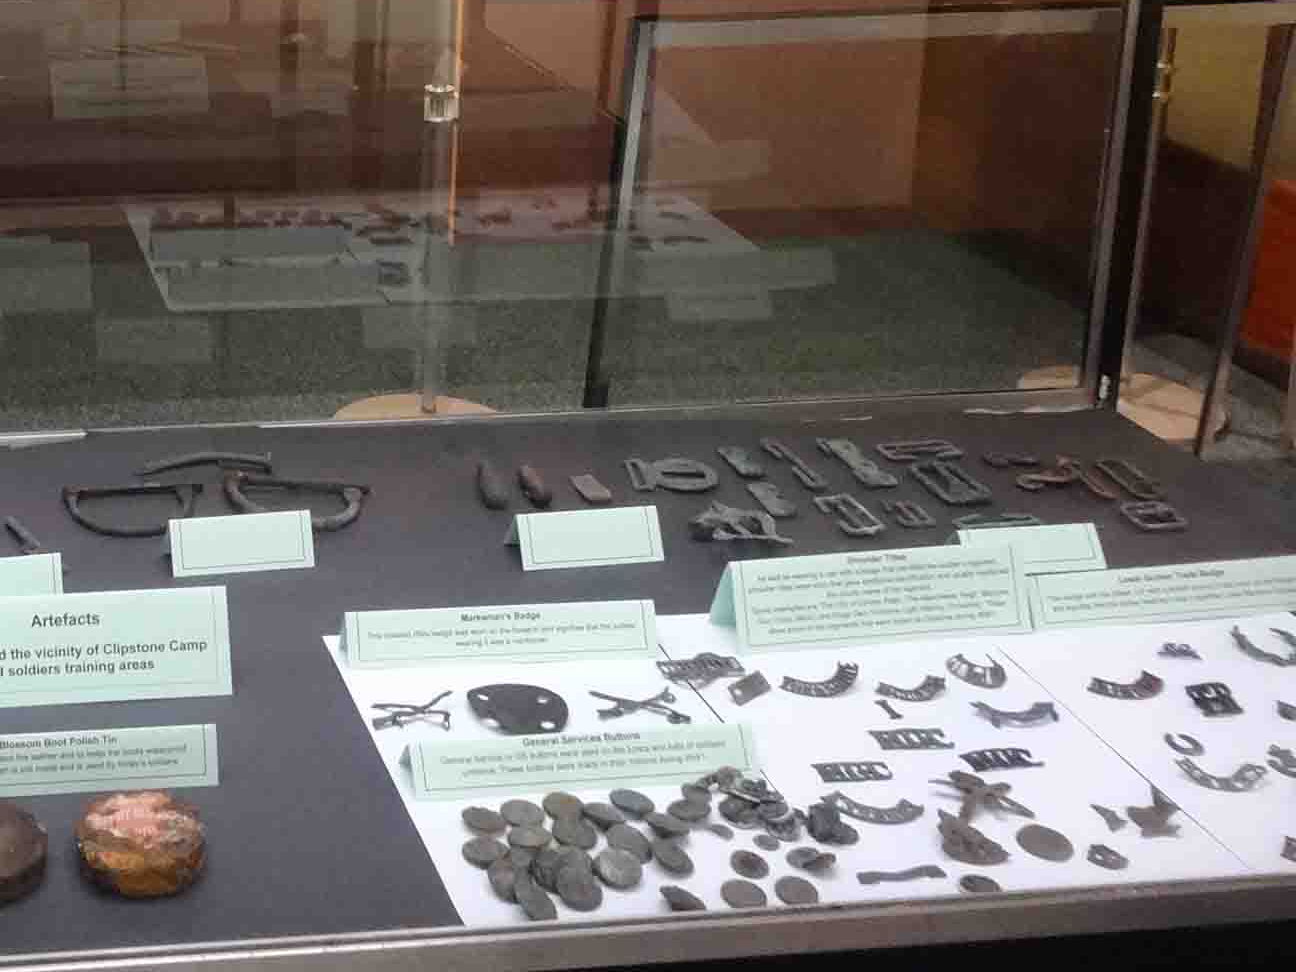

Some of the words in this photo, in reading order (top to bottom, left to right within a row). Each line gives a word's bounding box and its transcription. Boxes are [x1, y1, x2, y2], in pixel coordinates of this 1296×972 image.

[30, 611, 101, 629] Artefacts
[10, 647, 33, 661] the
[34, 644, 83, 662] vicinity
[86, 643, 101, 657] of
[102, 640, 166, 657] Clipstone
[168, 638, 208, 654] Camp
[7, 662, 62, 677] soldiers
[64, 659, 116, 676] training
[118, 658, 155, 672] areas
[0, 738, 43, 751] Blossom
[69, 735, 100, 747] Polish
[522, 735, 560, 748] General
